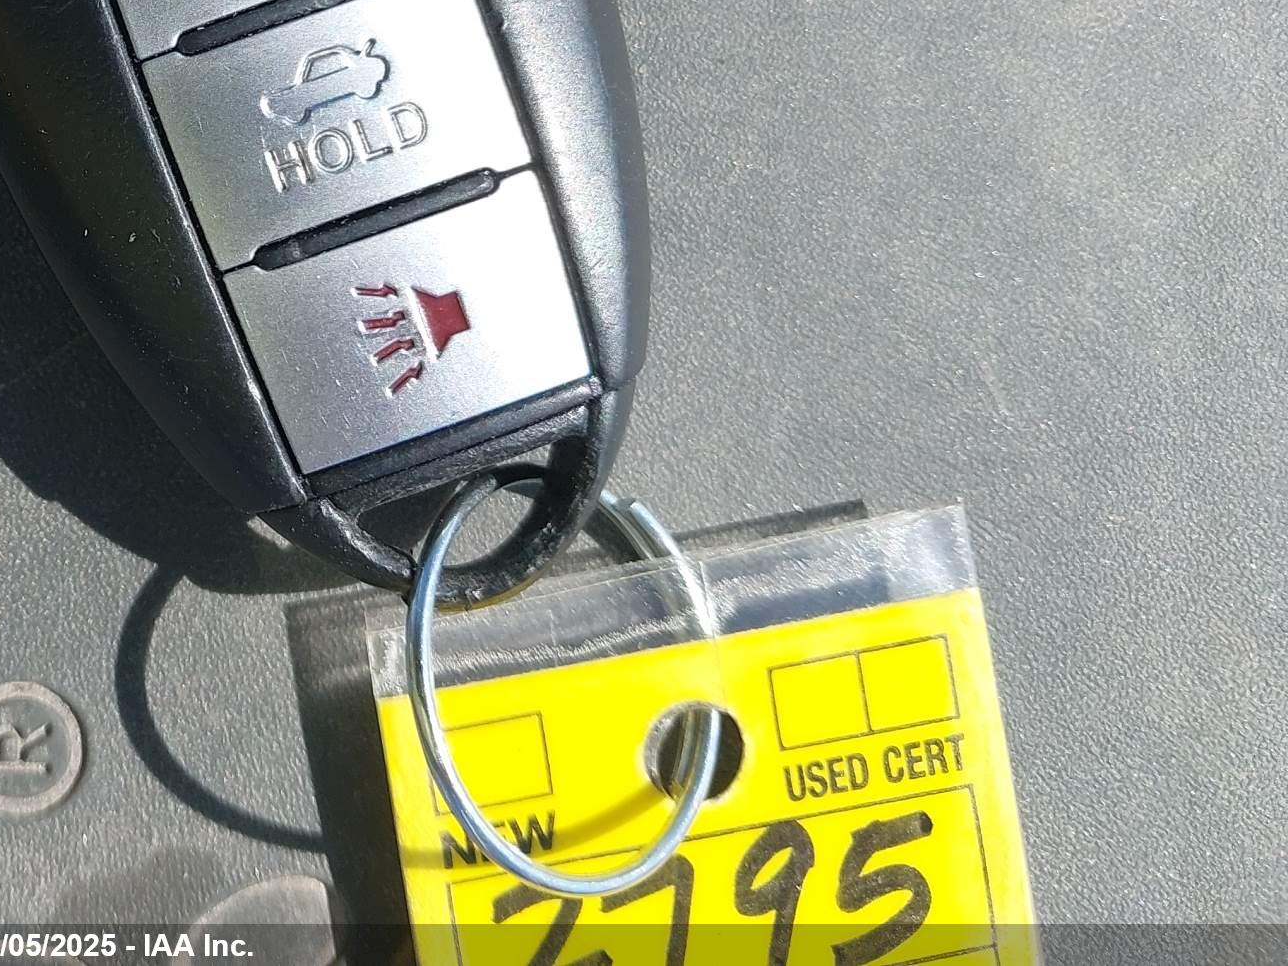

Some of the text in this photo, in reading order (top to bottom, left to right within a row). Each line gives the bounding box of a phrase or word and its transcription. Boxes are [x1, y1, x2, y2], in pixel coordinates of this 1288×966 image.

[263, 101, 428, 194] HOLD
[782, 732, 965, 802] USED CERT
